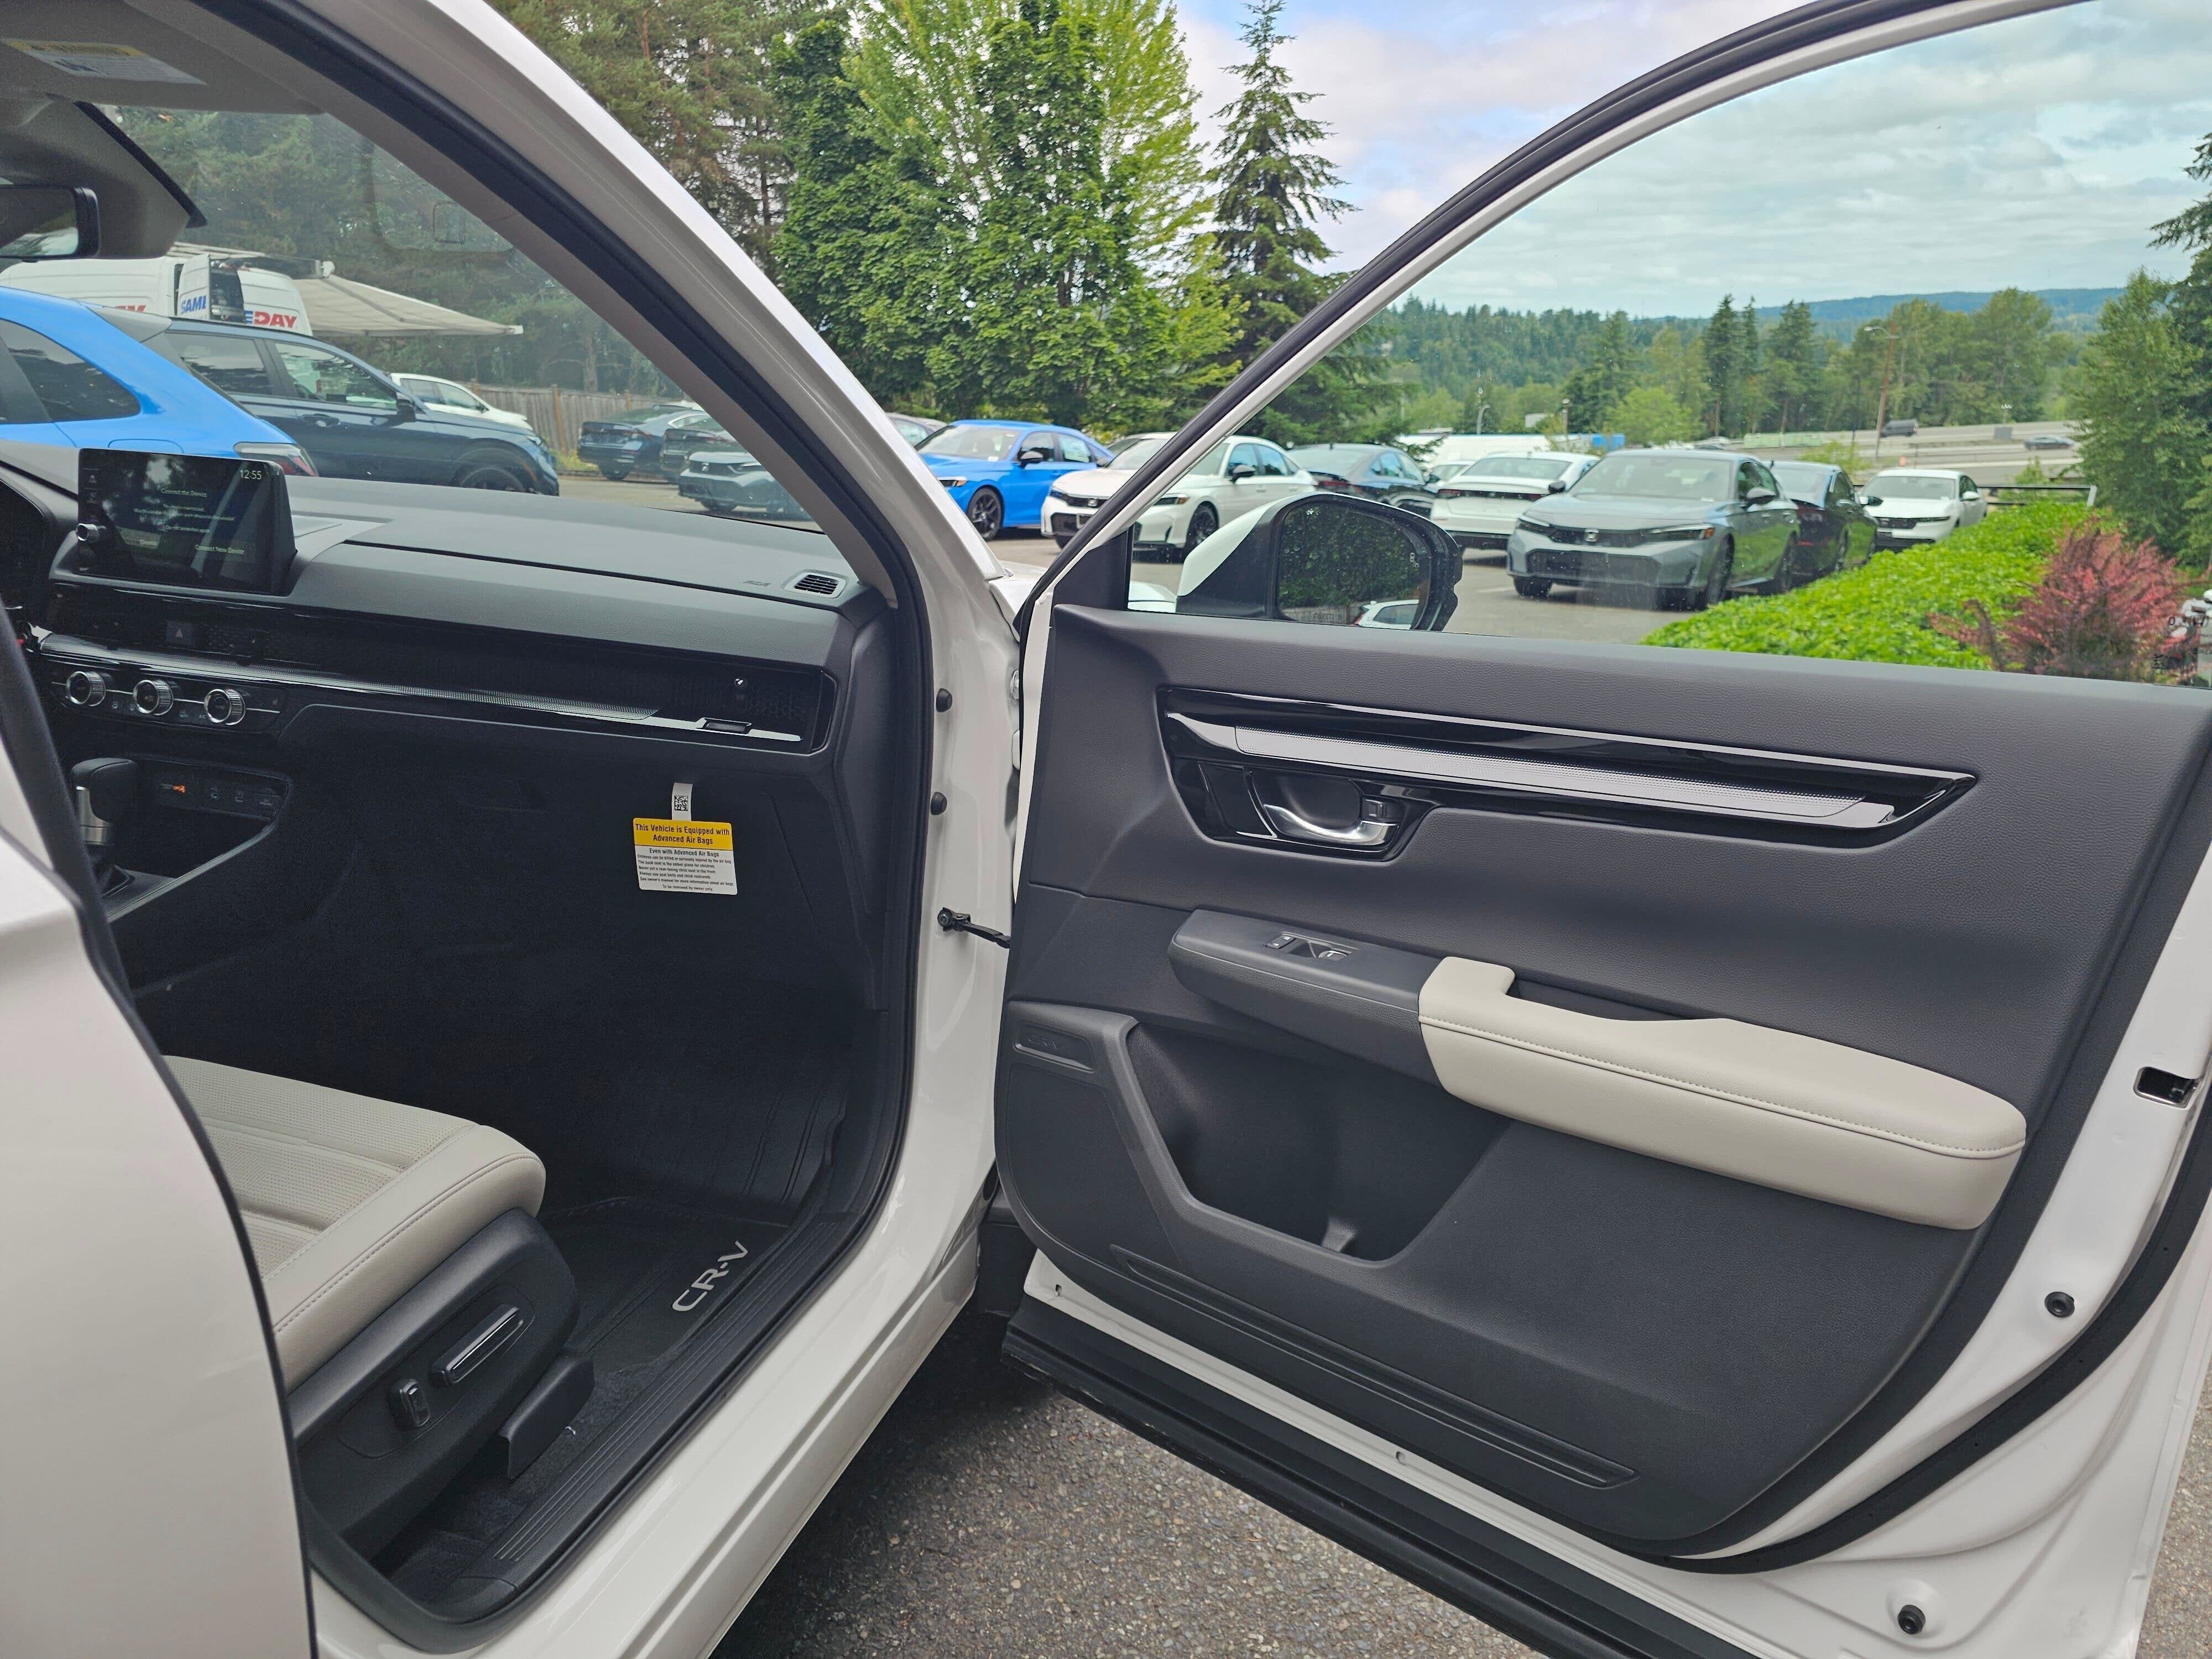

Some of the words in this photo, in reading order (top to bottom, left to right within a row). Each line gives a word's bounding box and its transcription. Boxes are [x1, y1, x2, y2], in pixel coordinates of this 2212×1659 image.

[240, 469, 262, 480] 12:55
[684, 826, 714, 836] Equipped
[653, 834, 684, 843] Advanced
[672, 1240, 748, 1311] CR-V
